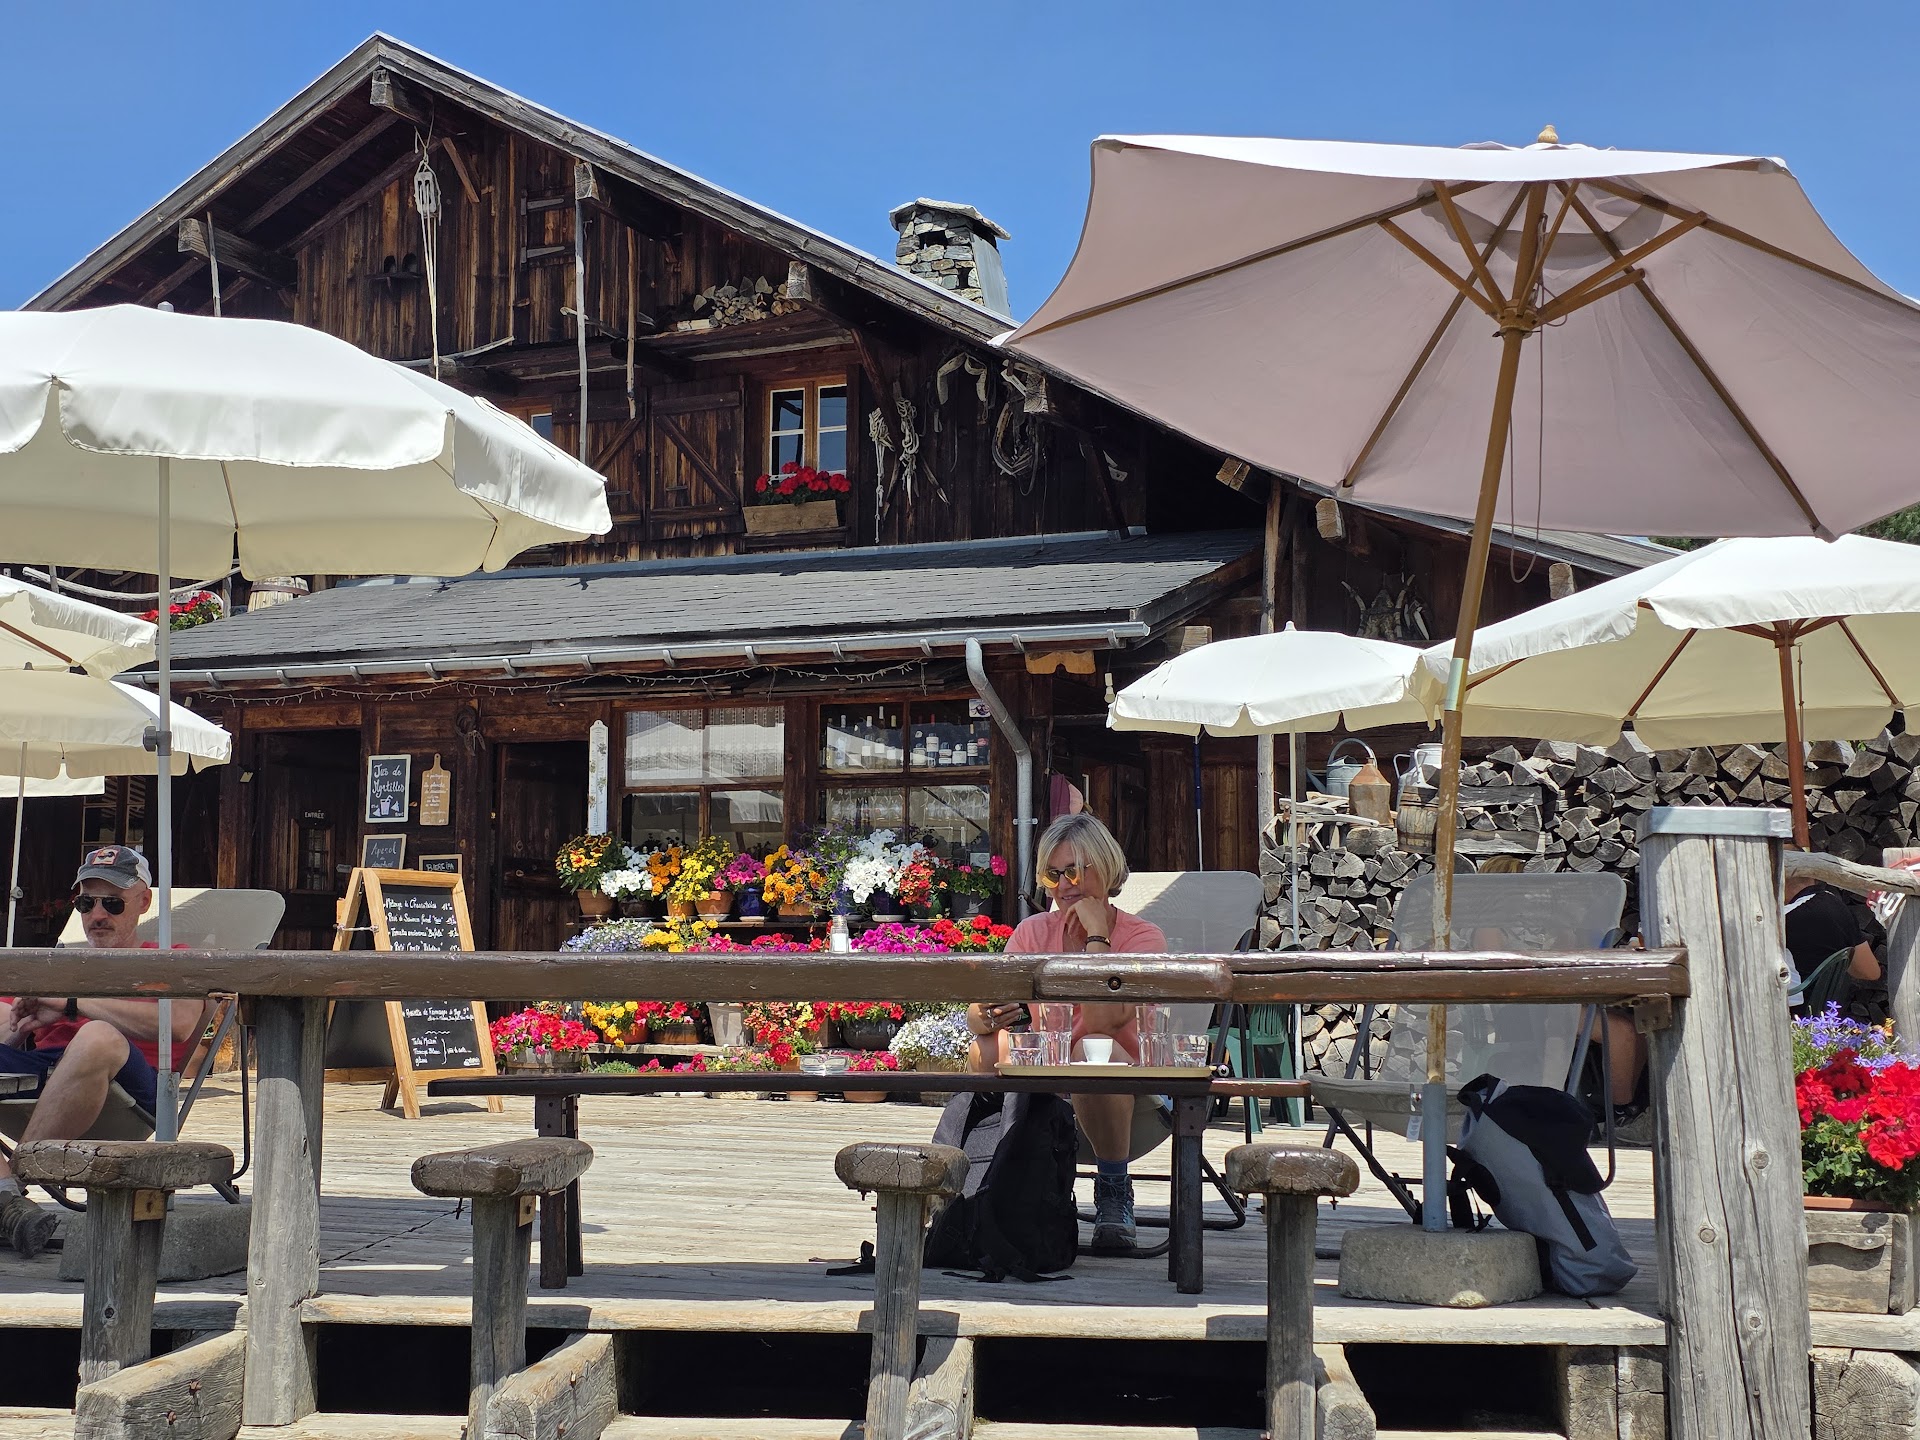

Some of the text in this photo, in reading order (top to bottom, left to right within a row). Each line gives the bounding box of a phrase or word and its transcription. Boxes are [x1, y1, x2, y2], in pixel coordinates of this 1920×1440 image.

[374, 764, 402, 778] Jus de
[372, 780, 404, 798] Myrtilles
[304, 810, 324, 819] ENTRÉE
